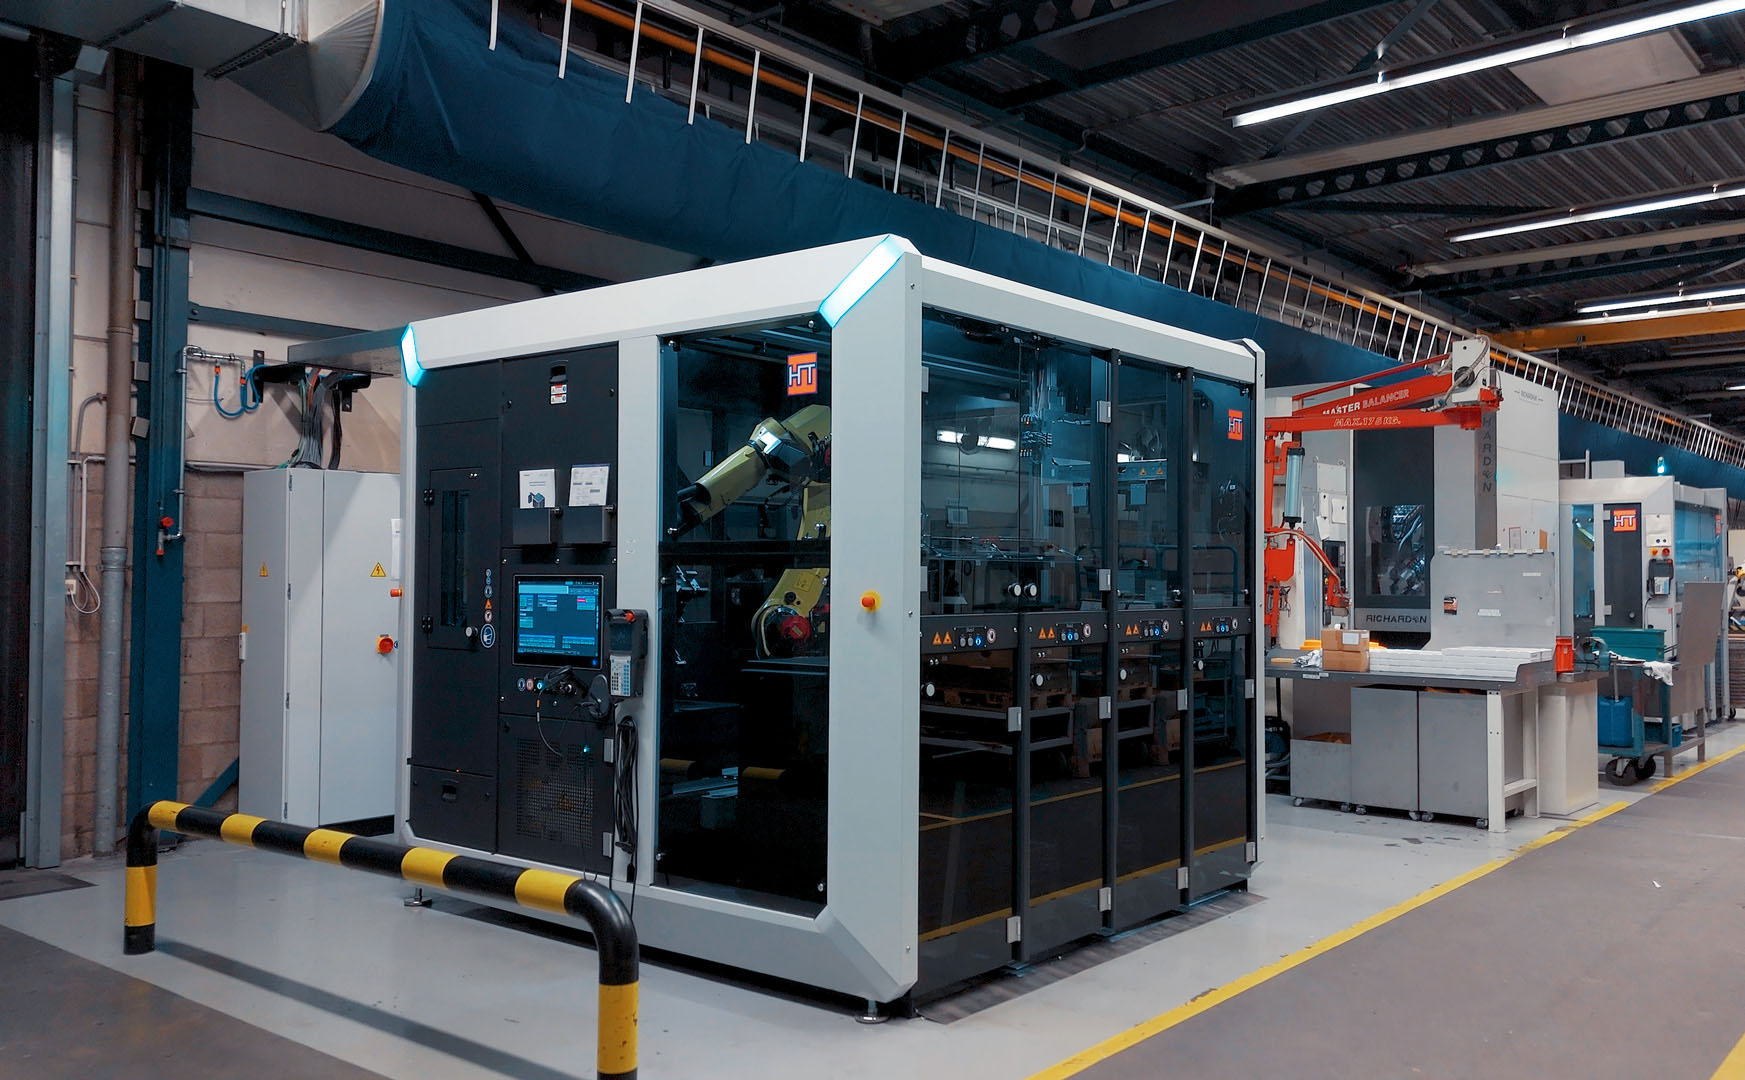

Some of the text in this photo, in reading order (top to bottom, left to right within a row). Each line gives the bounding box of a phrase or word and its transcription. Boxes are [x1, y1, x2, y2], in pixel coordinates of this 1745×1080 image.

[788, 362, 816, 386] HT
[1362, 389, 1409, 408] BALANCER
[1228, 416, 1243, 434] HT
[1613, 514, 1636, 528] HT
